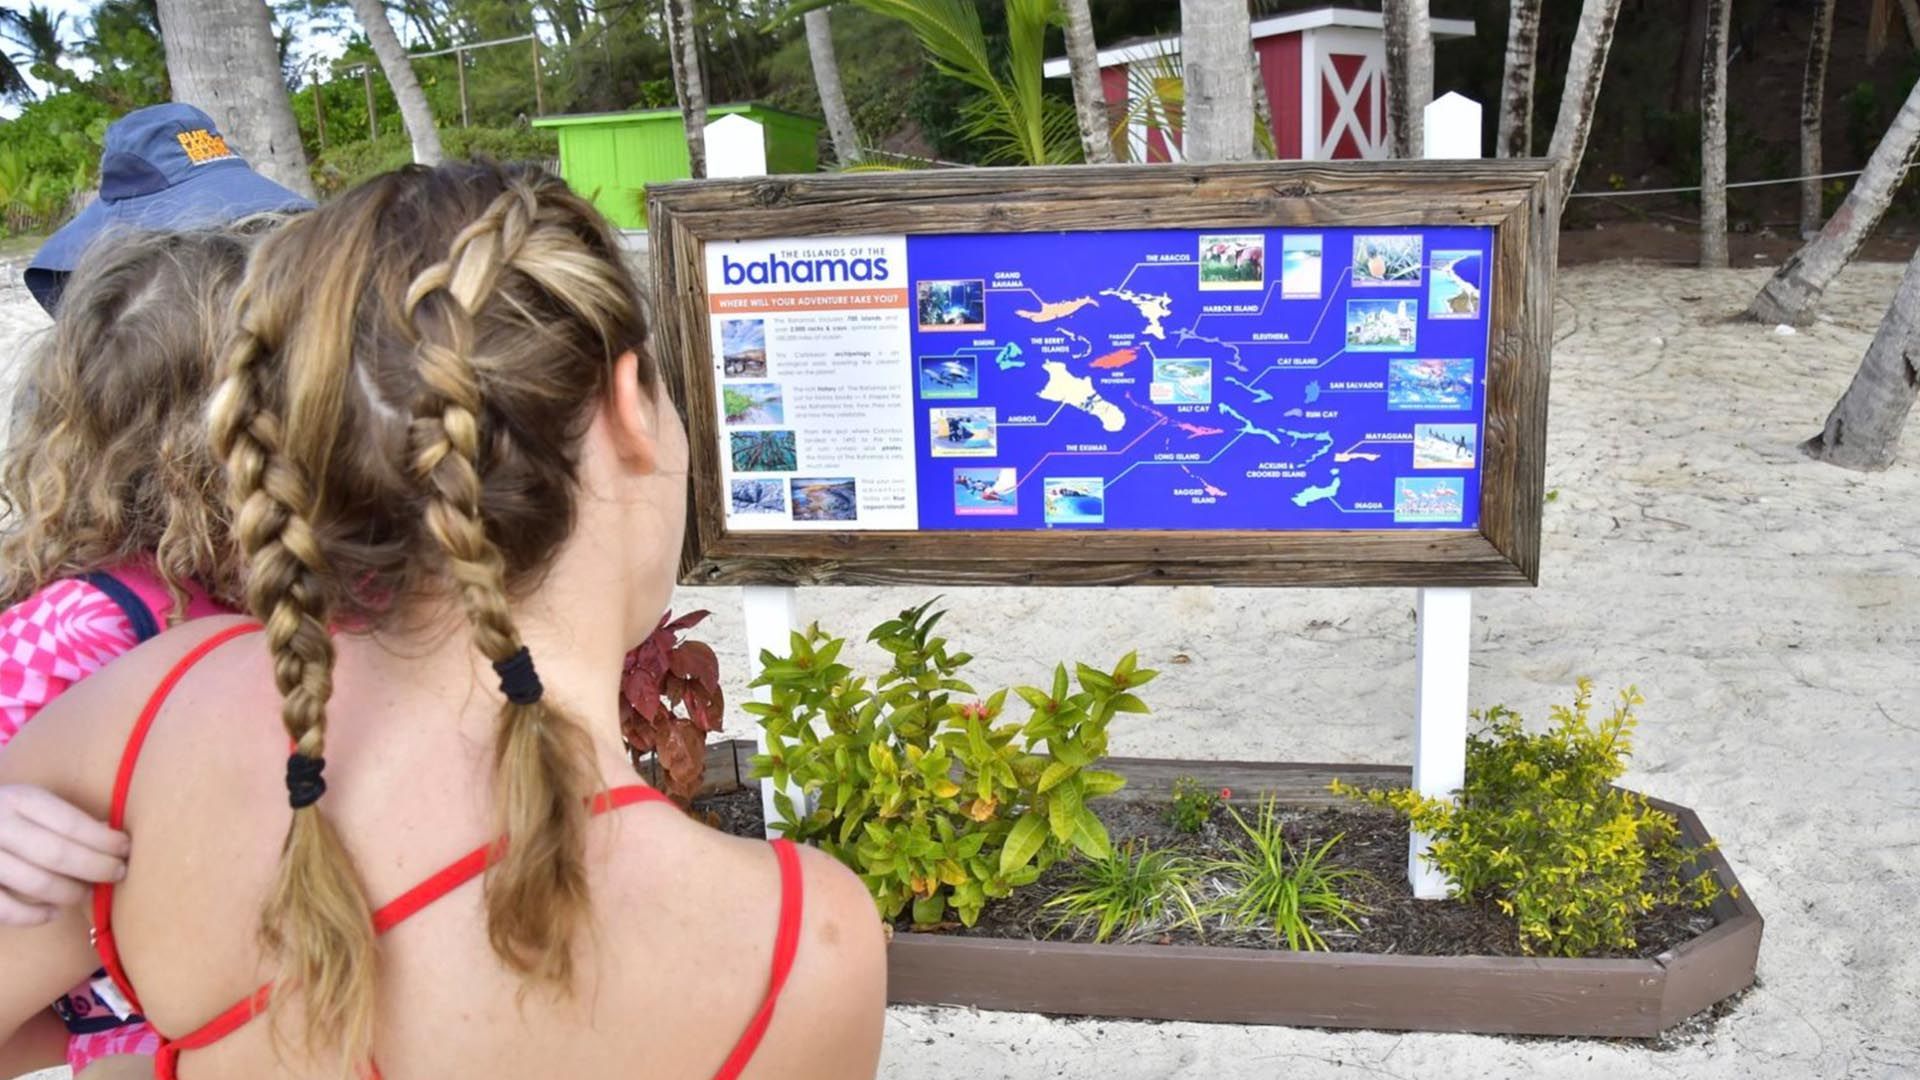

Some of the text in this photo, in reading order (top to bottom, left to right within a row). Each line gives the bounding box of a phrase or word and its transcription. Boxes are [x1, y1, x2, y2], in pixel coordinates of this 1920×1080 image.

[781, 247, 885, 258] THE ISLANDS OF THE
[722, 253, 889, 285] bahamas
[992, 280, 1023, 288] BAHAMA
[719, 294, 899, 308] WHERE WILL YOUR ADVENTURE TAKE YOU?
[1252, 333, 1289, 341] ELEUTHERA
[1177, 405, 1193, 413] SALT
[1008, 415, 1037, 423] ANDROS
[1154, 453, 1175, 461] LONG
[1246, 470, 1307, 478] CROOKED ISLAND
[1173, 488, 1203, 496] RAGGED
